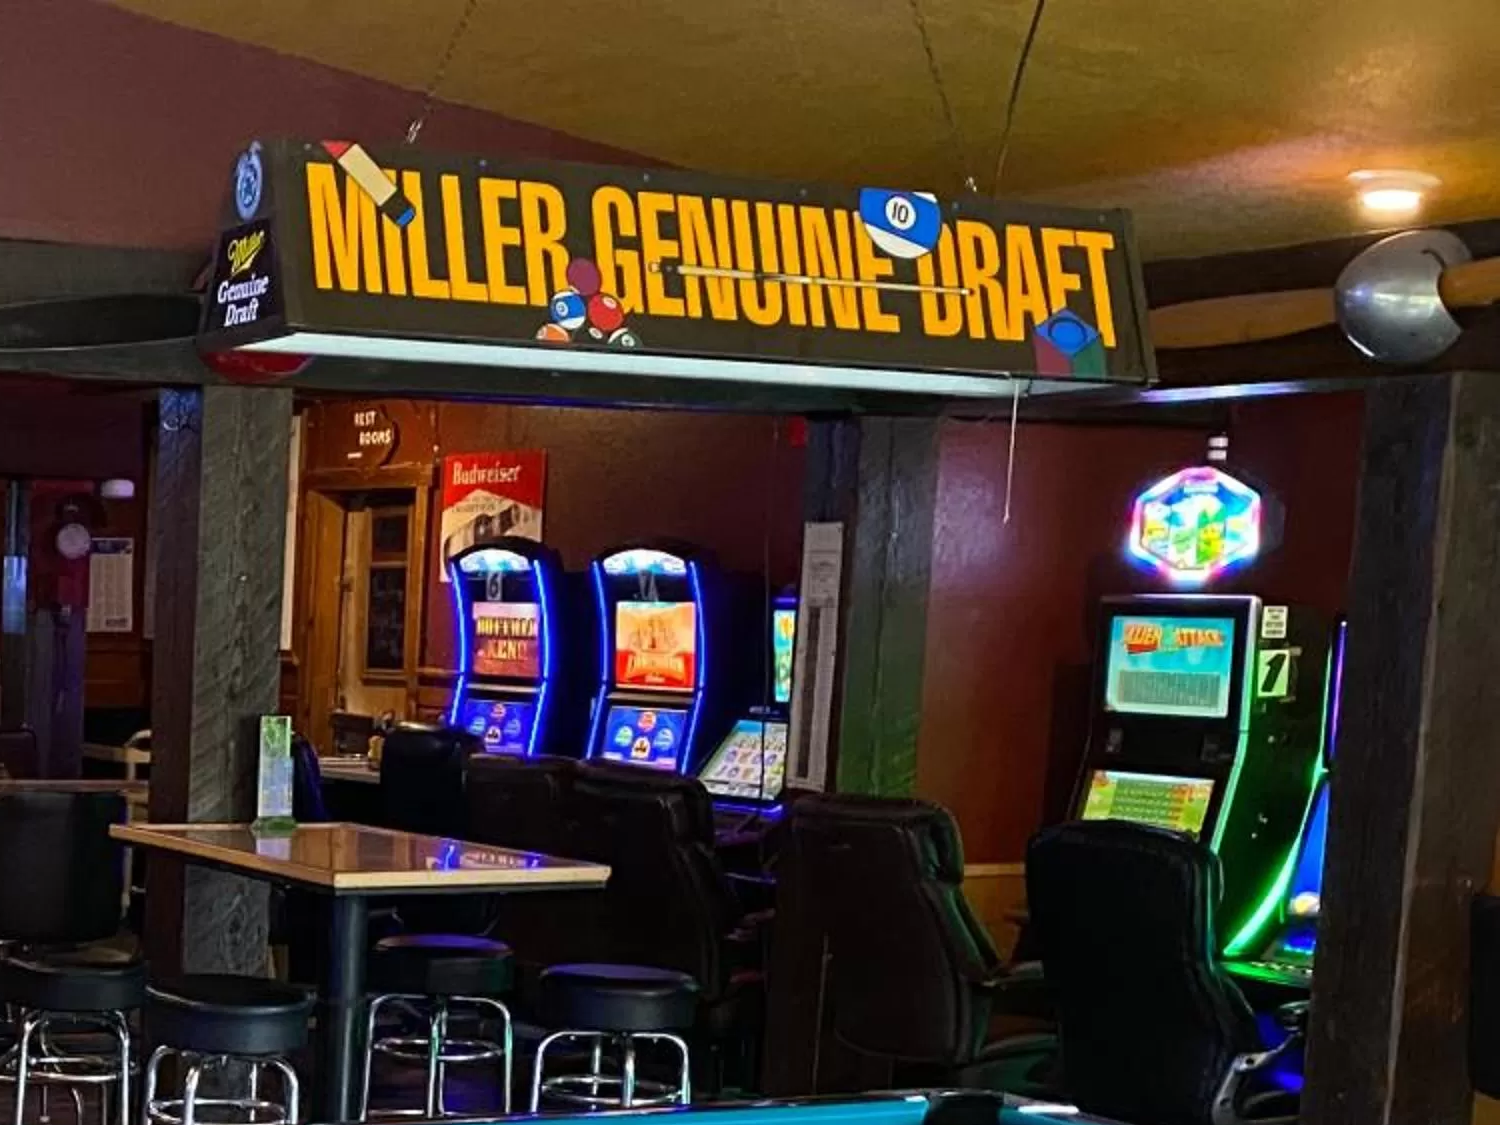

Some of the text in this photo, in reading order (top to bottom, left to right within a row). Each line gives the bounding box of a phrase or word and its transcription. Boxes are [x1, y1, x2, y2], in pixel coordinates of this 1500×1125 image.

[891, 201, 909, 224] 10
[227, 229, 266, 274] Miller
[306, 162, 1117, 349] MILLER GENUINE DRAFT
[217, 275, 269, 304] Genuine
[223, 297, 259, 327] Draft
[452, 460, 522, 486] Budweiser
[1260, 652, 1288, 693] 1
